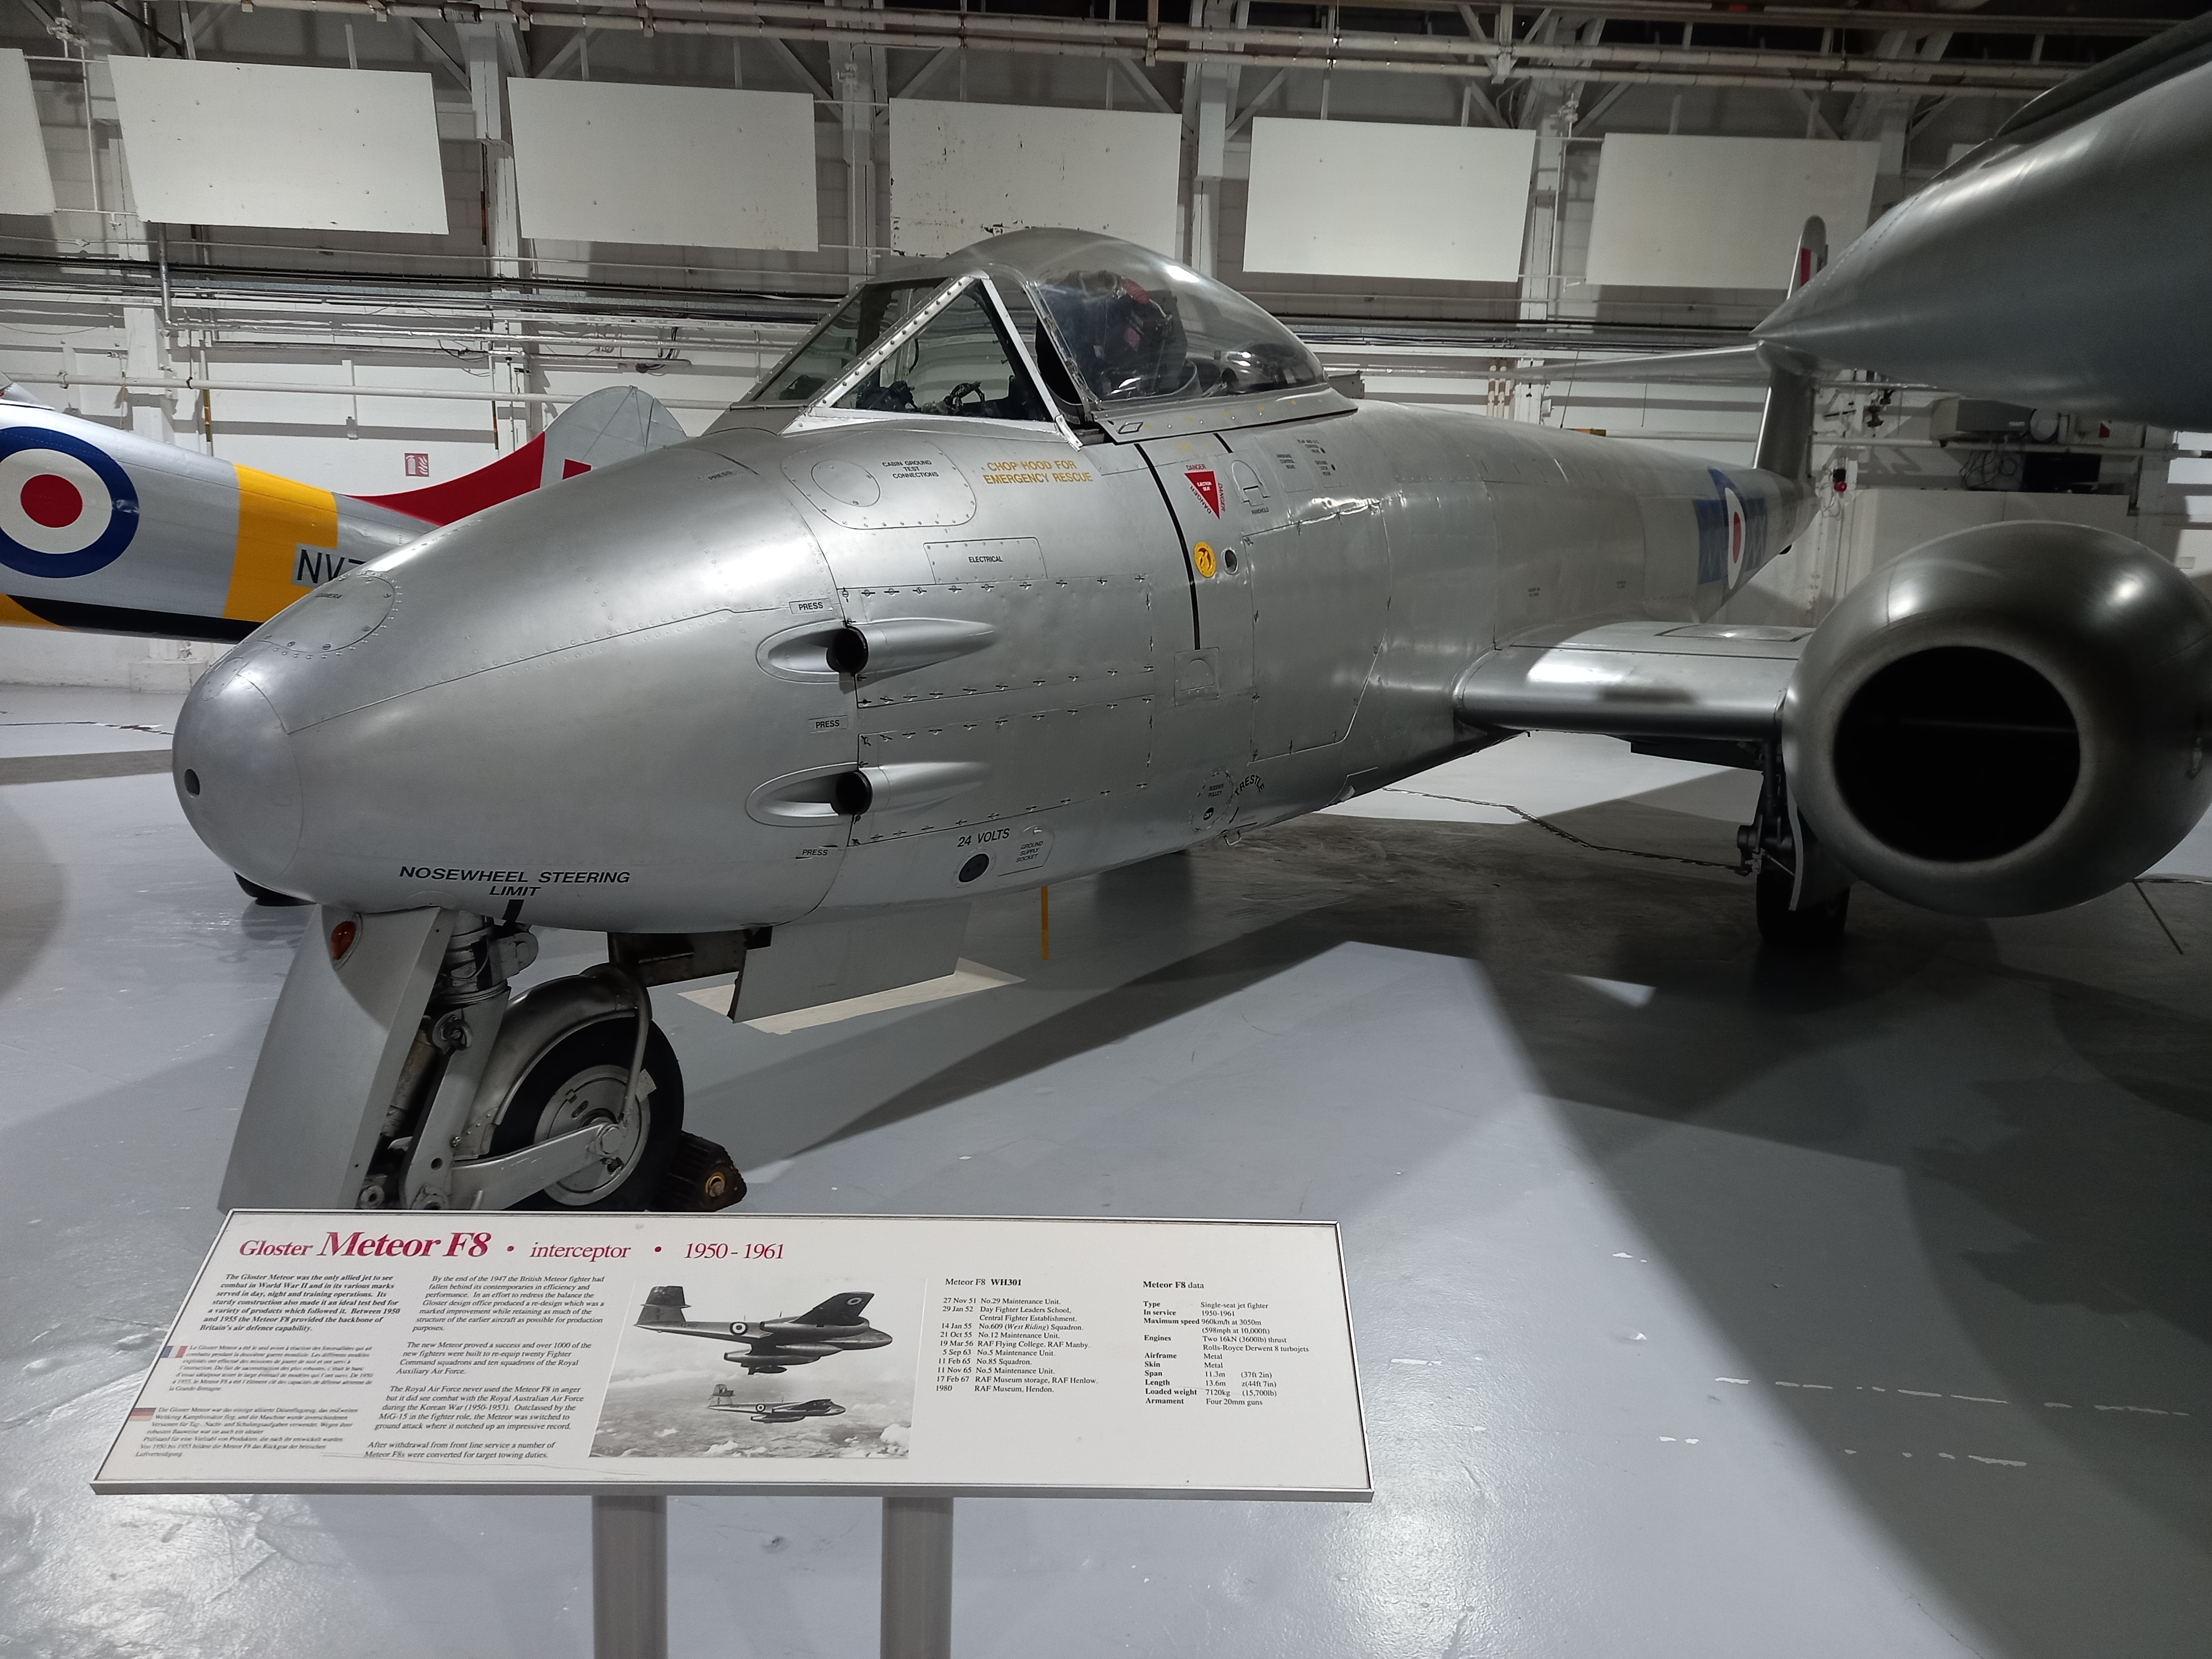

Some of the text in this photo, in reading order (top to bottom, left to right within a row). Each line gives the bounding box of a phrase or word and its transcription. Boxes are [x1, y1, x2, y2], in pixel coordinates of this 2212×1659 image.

[987, 460, 1077, 471] CHOP HOOD FOR
[984, 472, 1093, 484] EMERGENCY RESCUE
[1190, 484, 1212, 514] DANGER
[1218, 482, 1226, 512] DANGER
[297, 549, 367, 583] NV
[798, 602, 823, 611] PRESS
[816, 719, 840, 728] PRESS
[1234, 774, 1265, 796] TRESTLE
[957, 828, 1010, 847] 24 VOLTS
[1021, 841, 1043, 849] GROUND
[1020, 848, 1040, 857] SUPPLY
[1016, 854, 1039, 862] SOCKET
[399, 866, 630, 883] NOSEWHEEL STEERING
[489, 886, 541, 896] LIMIT
[239, 1240, 314, 1256] Gloster
[316, 1232, 442, 1257] Meteor
[442, 1232, 492, 1258] F8
[529, 1242, 632, 1262] interceptor
[432, 1276, 443, 1285] By
[1203, 1344, 1244, 1353] Rolls-Royce
[1145, 1370, 1163, 1378] Span
[1145, 1379, 1170, 1387] Length
[1173, 1389, 1197, 1397] weight
[1205, 1389, 1231, 1397] 7120kg
